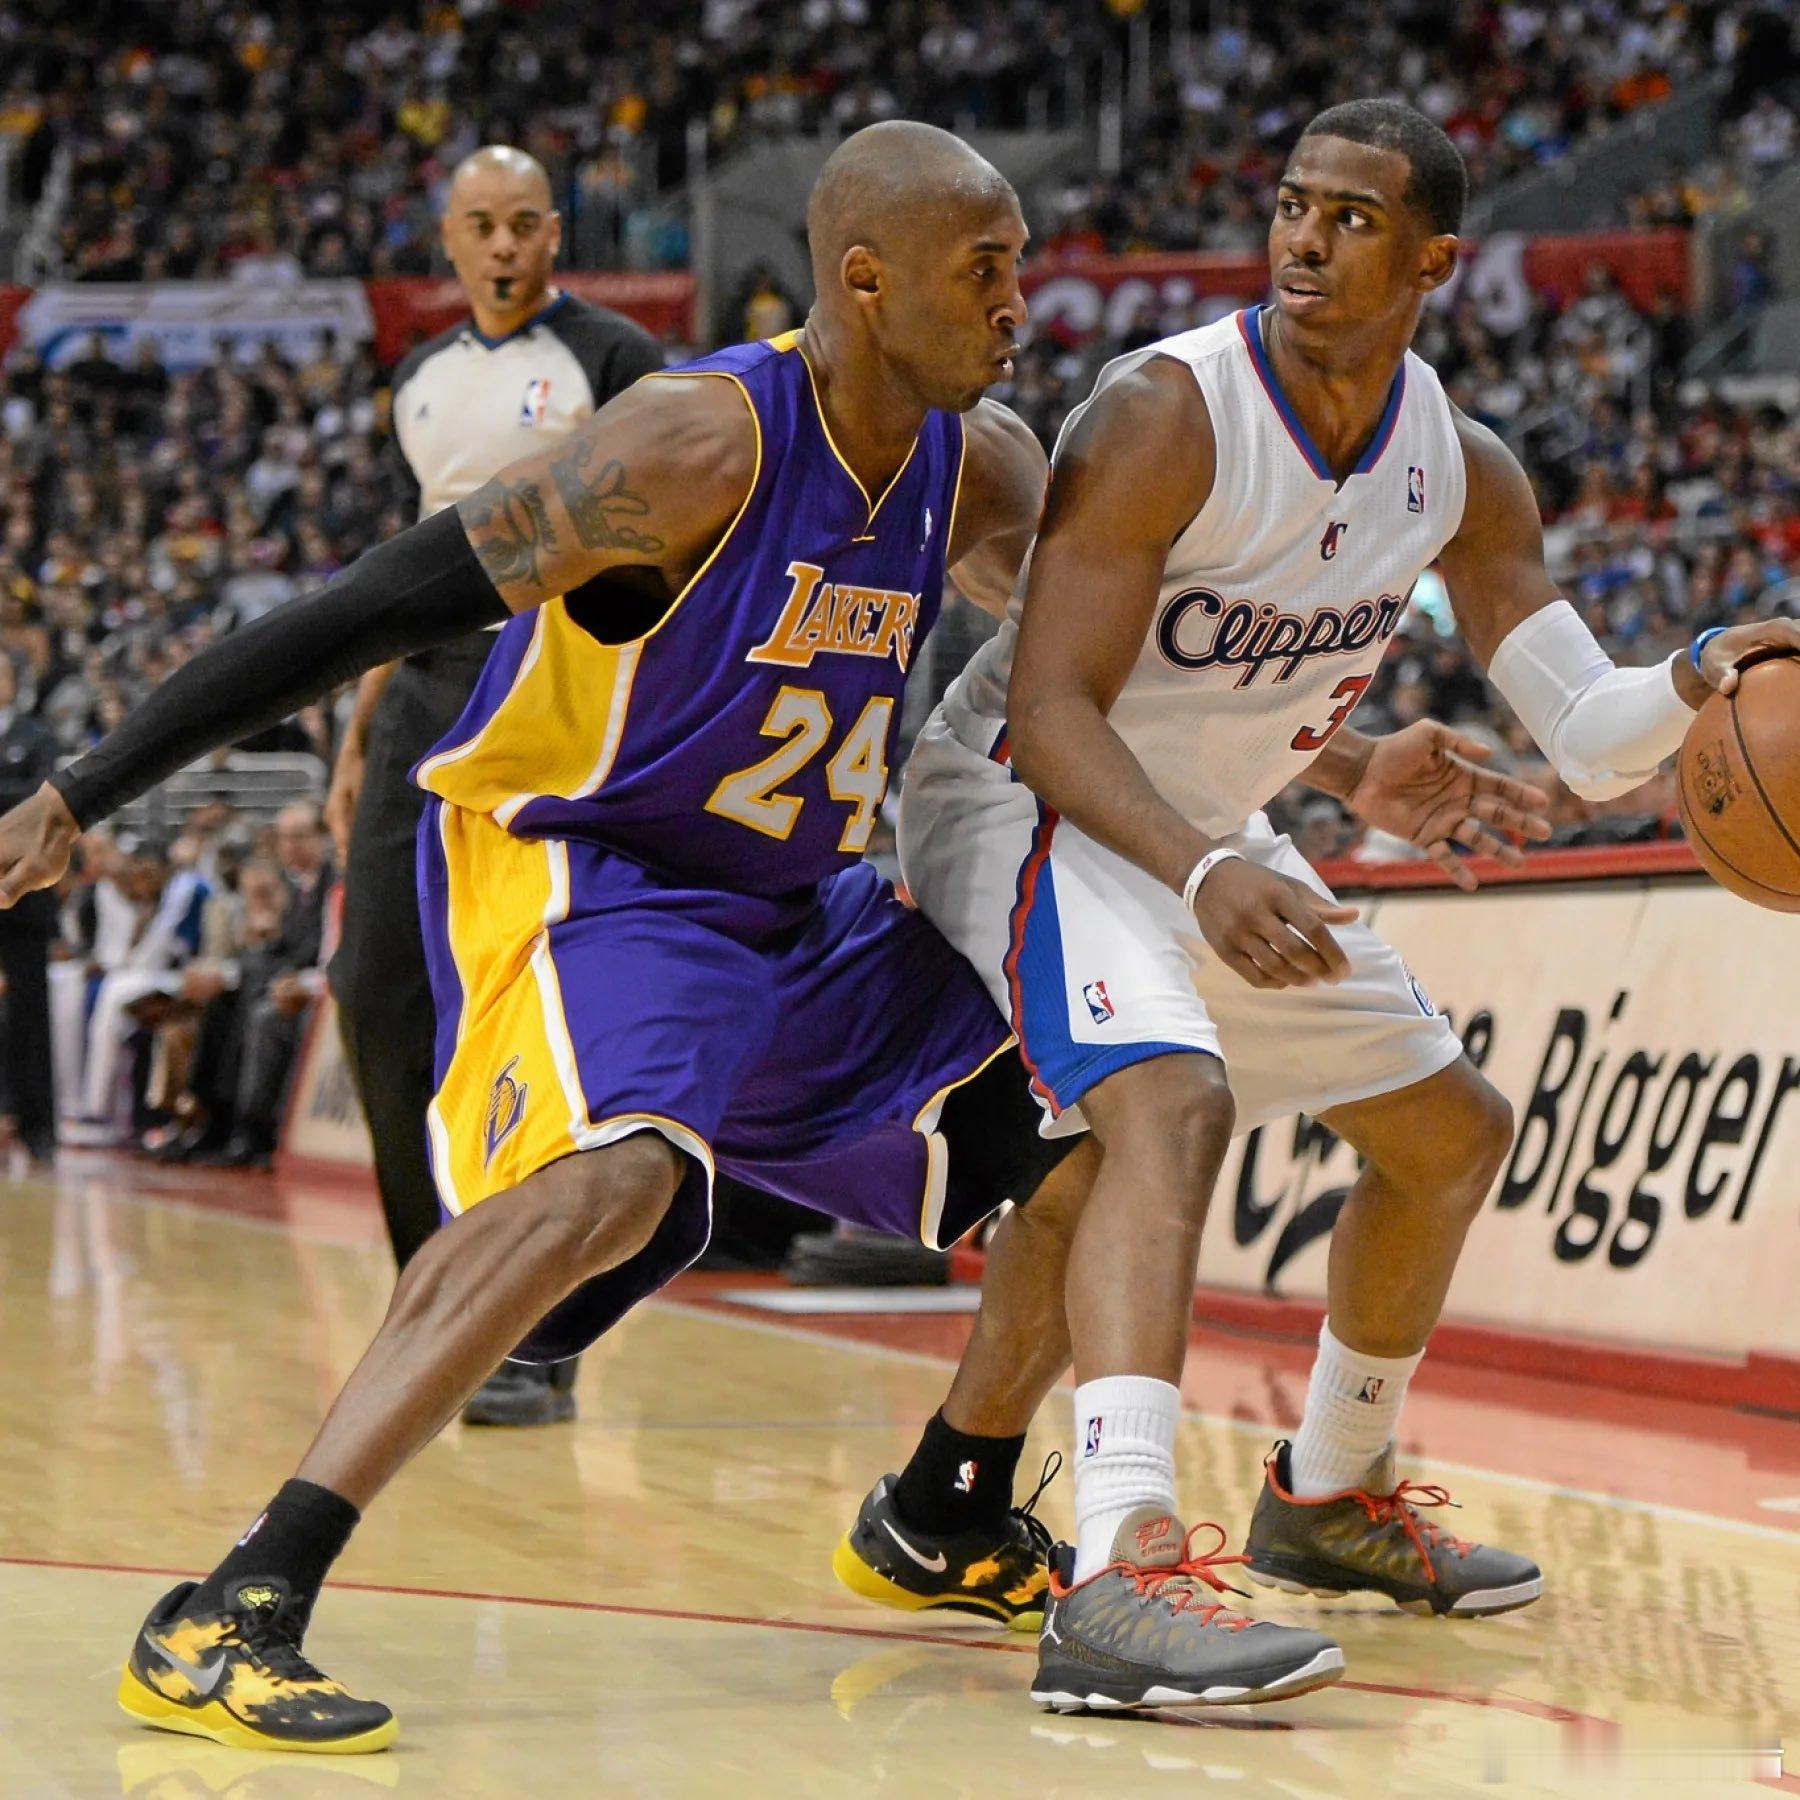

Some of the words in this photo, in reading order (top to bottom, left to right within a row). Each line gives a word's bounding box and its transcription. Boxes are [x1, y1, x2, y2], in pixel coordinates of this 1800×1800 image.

[1156, 586, 1406, 690] Clipper
[704, 684, 894, 853] 24
[1290, 672, 1375, 751] 3
[1496, 989, 1800, 1269] Bigger
